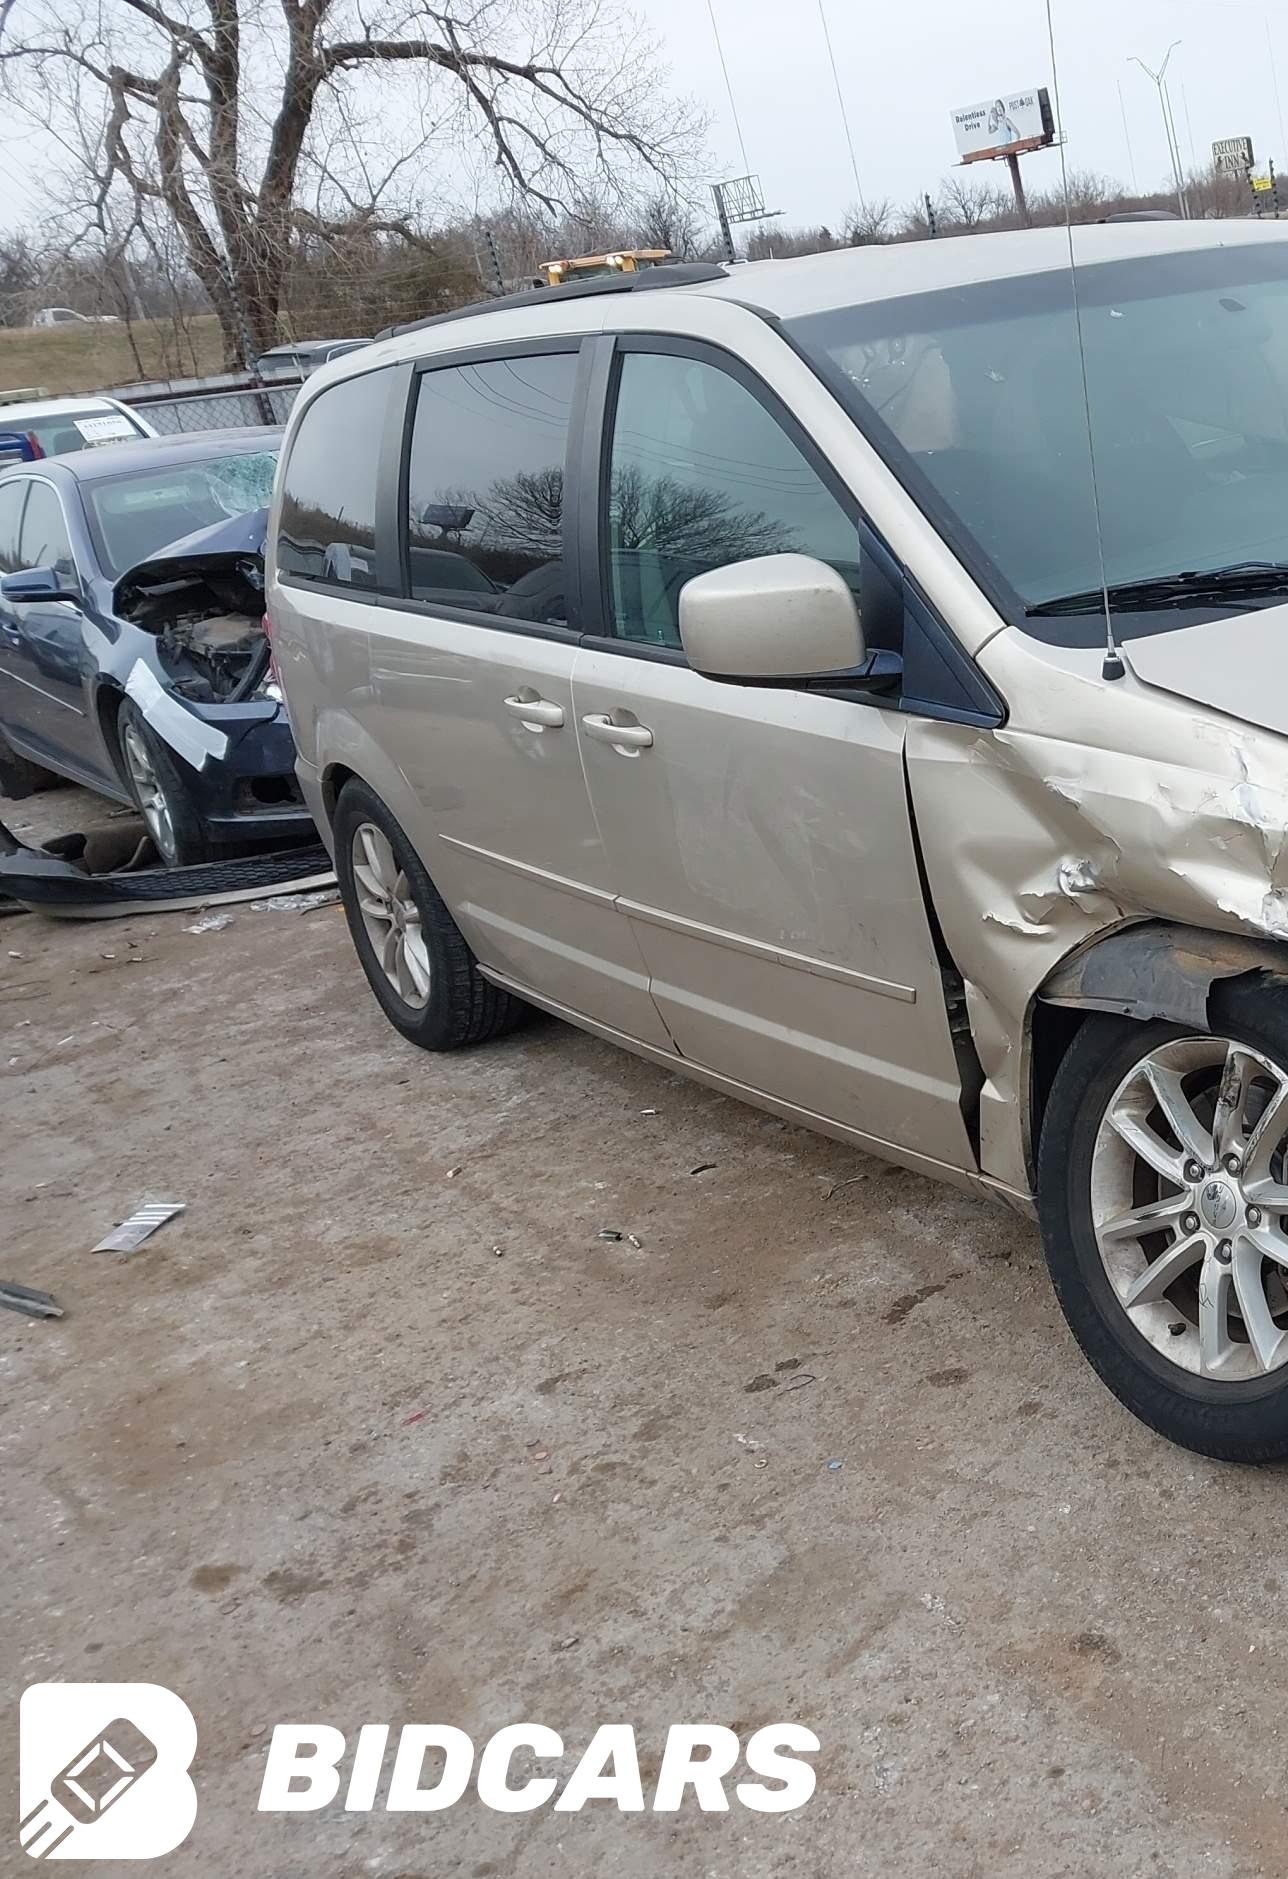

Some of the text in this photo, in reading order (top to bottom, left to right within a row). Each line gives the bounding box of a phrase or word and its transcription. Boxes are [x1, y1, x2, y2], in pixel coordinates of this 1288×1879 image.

[955, 109, 986, 123] Relentless
[964, 121, 981, 132] Drive
[1213, 138, 1247, 155] EXECUTIVE
[1224, 153, 1240, 169] INN
